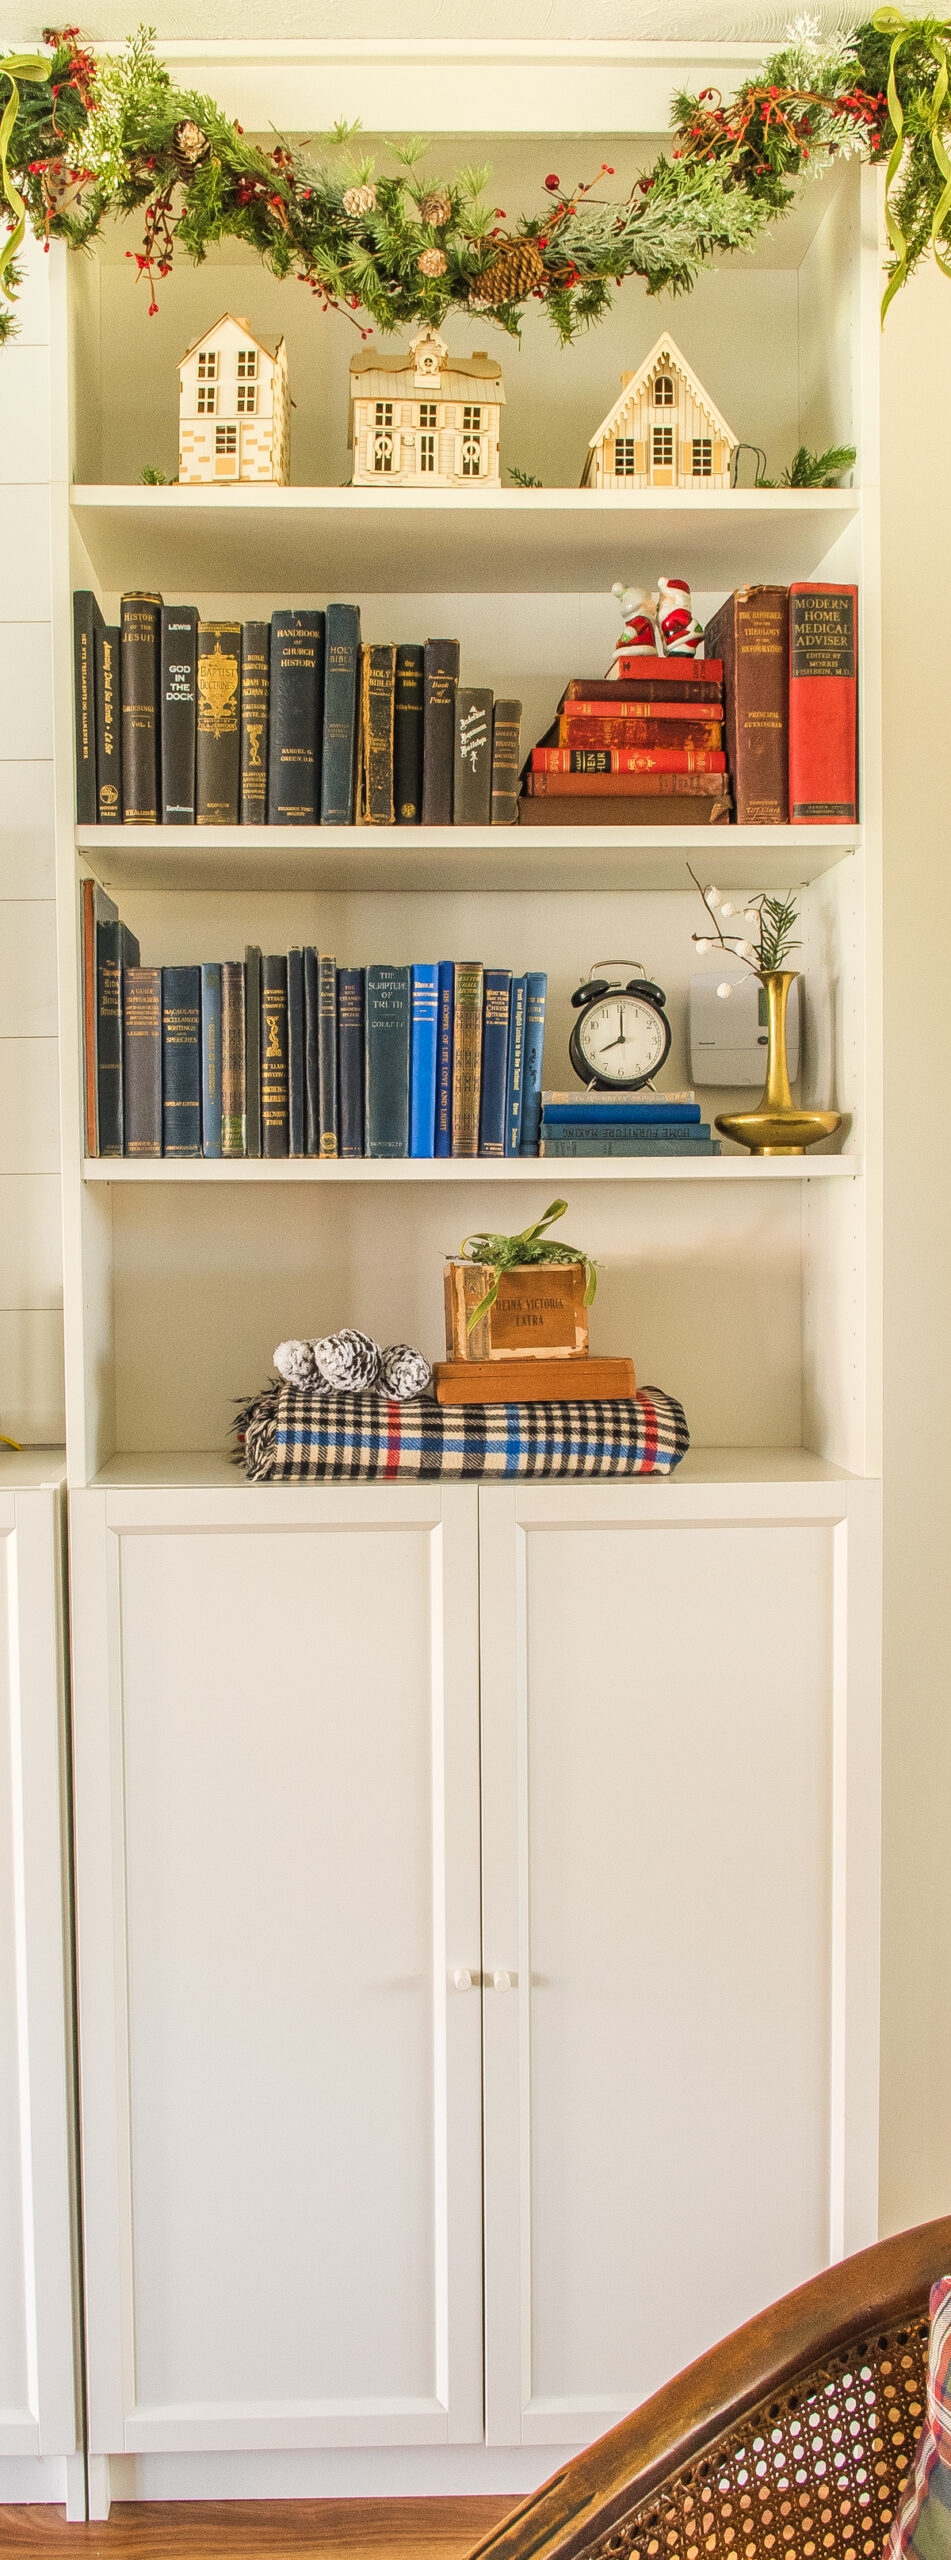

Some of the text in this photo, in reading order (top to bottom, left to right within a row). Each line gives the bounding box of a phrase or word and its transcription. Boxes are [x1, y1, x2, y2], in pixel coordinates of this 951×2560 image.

[794, 599, 848, 609] MODERN
[804, 611, 841, 621] HOME
[168, 623, 191, 631] LEWIS
[296, 619, 302, 627] A
[794, 623, 850, 634] MEDICAL
[277, 629, 320, 638] HANDBOOK
[796, 635, 848, 647] ADVISER
[282, 648, 314, 656] CHURCH
[330, 646, 354, 654] HOLY
[281, 659, 316, 668] HISTORY
[329, 655, 353, 663] BIBLE
[169, 665, 191, 673] GOD
[200, 665, 235, 677] BAPTIST
[370, 669, 391, 678] HOLY
[175, 674, 185, 682] IN
[170, 683, 190, 691] THE
[200, 679, 236, 690] DOCTRINES
[166, 692, 194, 700] DOCK
[437, 689, 446, 697] of
[748, 711, 779, 719] PRINCIPAL
[586, 752, 595, 773] BEN
[596, 751, 606, 773] HUR
[368, 982, 407, 990] SCRIPTURE
[381, 991, 393, 999] OF
[442, 989, 450, 1002] HIS
[373, 1000, 403, 1009] TRUTH
[486, 1004, 508, 1012] CHRIST
[442, 1004, 450, 1031] GOSPEL
[601, 1009, 609, 1019] 11
[635, 1009, 639, 1018] 1
[590, 1020, 599, 1030] 10
[646, 1020, 652, 1029] 2
[441, 1034, 449, 1045] OF
[584, 1035, 591, 1045] 9
[651, 1036, 658, 1046] 3
[589, 1051, 596, 1060] 8
[645, 1052, 652, 1060] 4
[602, 1062, 609, 1071] 7
[634, 1063, 641, 1073] 5
[441, 1066, 449, 1086] LOVE
[617, 1067, 625, 1077] 6
[440, 1089, 448, 1106] AND
[439, 1108, 447, 1131] LIGHT
[562, 1128, 690, 1138] HOME FURNITURE MAKING
[495, 1297, 564, 1311] REINA VICTORIA
[515, 1314, 544, 1327] EXTRA
